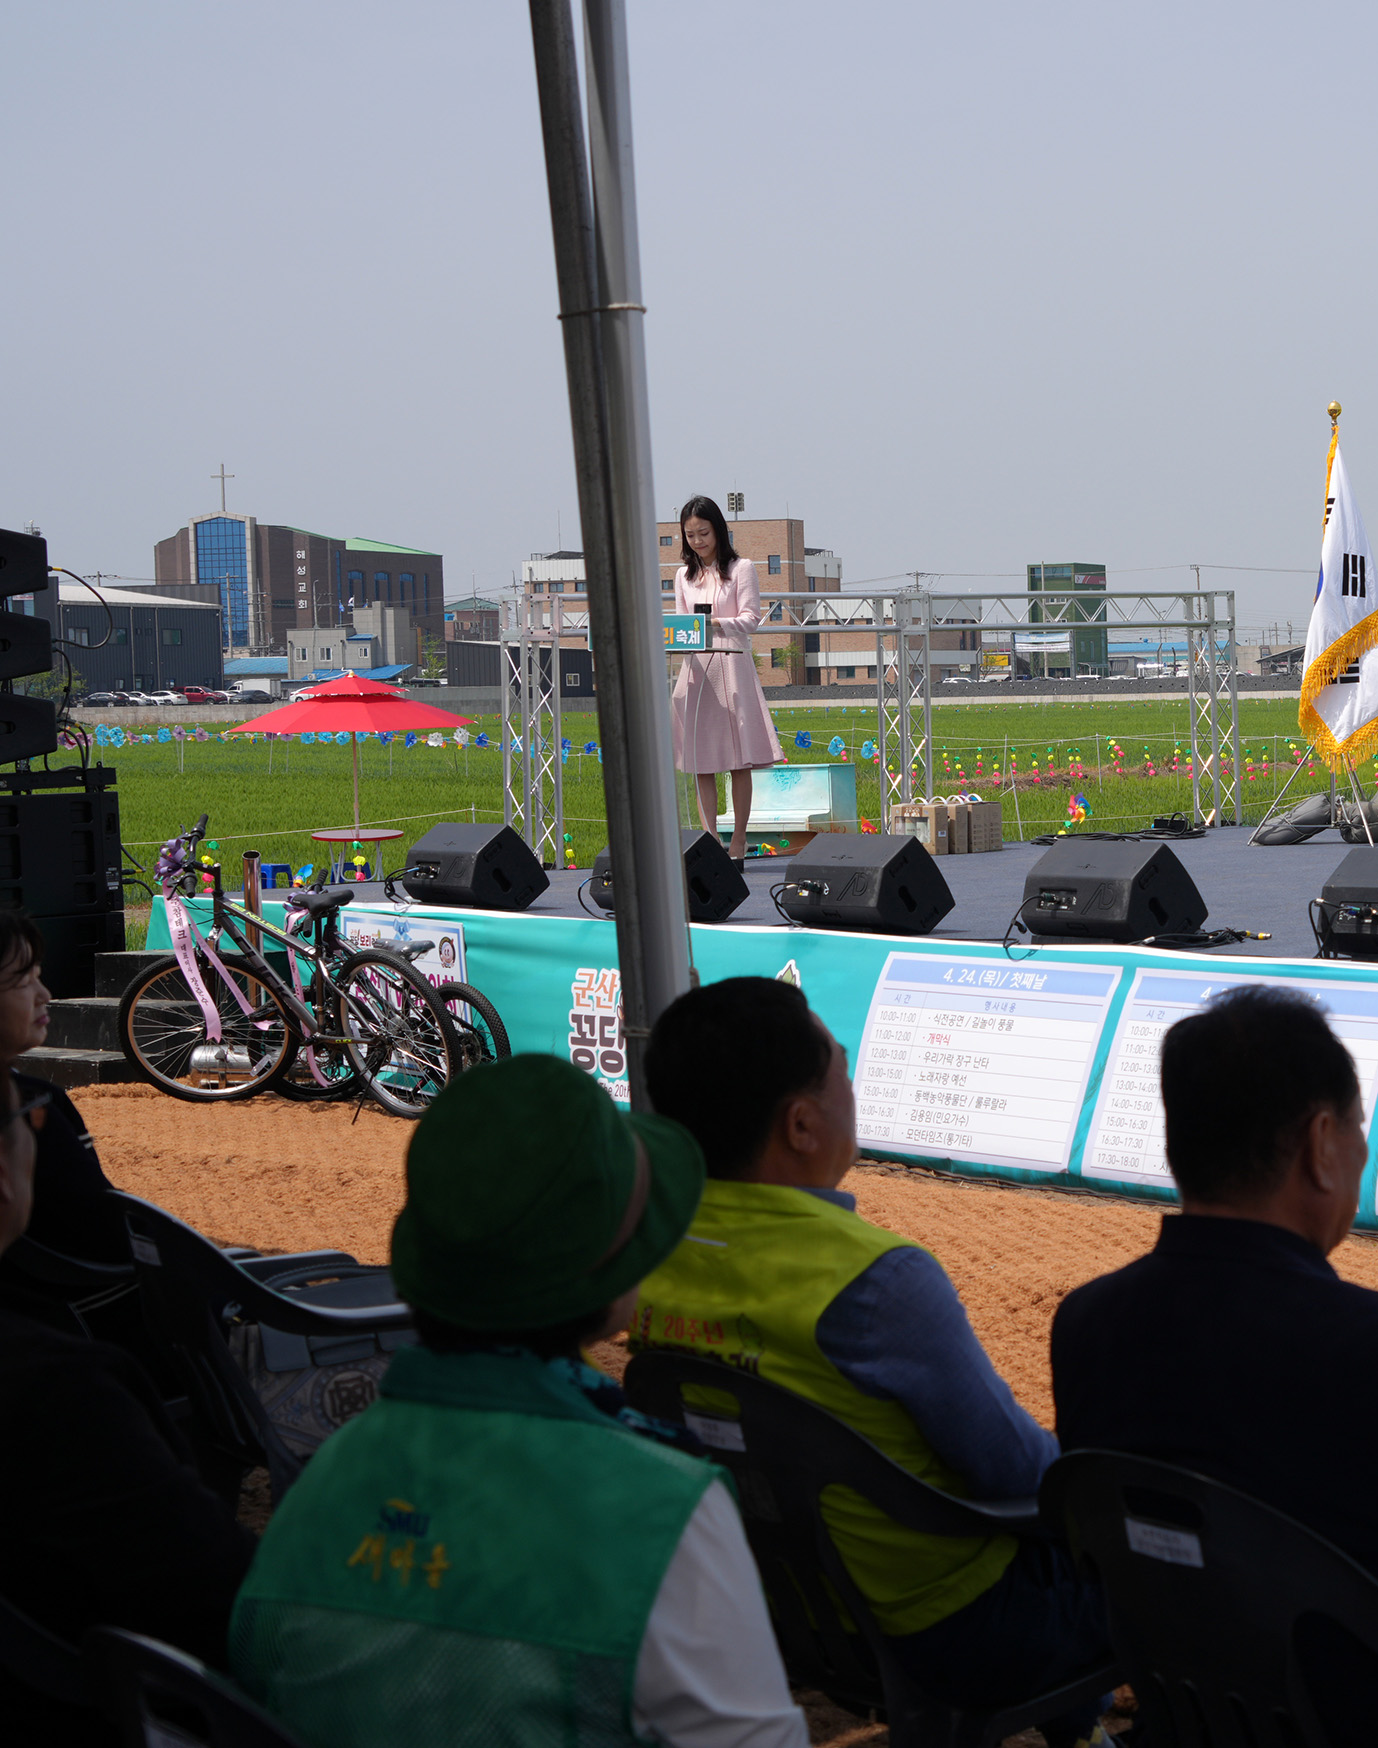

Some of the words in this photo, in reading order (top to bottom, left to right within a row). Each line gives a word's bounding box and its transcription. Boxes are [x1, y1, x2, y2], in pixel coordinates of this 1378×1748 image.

[296, 550, 307, 609] 해성교회
[676, 629, 700, 644] 축제
[1010, 972, 1048, 990] 첫째날
[574, 972, 617, 1009] 군산
[880, 1011, 916, 1022] 10:00~11:00
[933, 1013, 964, 1028] 식전공연
[972, 1016, 996, 1030] 길놀이
[997, 1018, 1014, 1031] 풍물
[875, 1029, 911, 1041] 11:00~12:00
[927, 1033, 951, 1046] 개막식
[570, 1013, 626, 1073] 꽁당
[871, 1048, 907, 1061] 12:00~13:00
[923, 1051, 954, 1065] 우리가락
[956, 1054, 971, 1067] 장구
[972, 1056, 989, 1069] 난타
[867, 1067, 903, 1079] 13:00~15:00
[918, 1071, 950, 1085] 노래자랑
[951, 1074, 967, 1086] 예선
[863, 1086, 899, 1098] 15:00~16:00
[1116, 1080, 1157, 1093] 13:00~14:00
[914, 1089, 968, 1107] 동백농악풍물단
[975, 1096, 1007, 1111] 룰루랄라
[1111, 1098, 1152, 1111] 14:00~15:00
[859, 1104, 894, 1117] 16:00~16:30
[910, 1110, 969, 1127] 김용임(민요가수)
[1106, 1116, 1148, 1130] 15:00~16:30
[906, 1129, 972, 1148] 모던타임즈(통기타)
[1101, 1135, 1143, 1148] 16:30~17:30
[1098, 1153, 1139, 1167] 17:30~18:00
[663, 1314, 724, 1345] 20주년
[346, 1526, 454, 1591] 새마을
